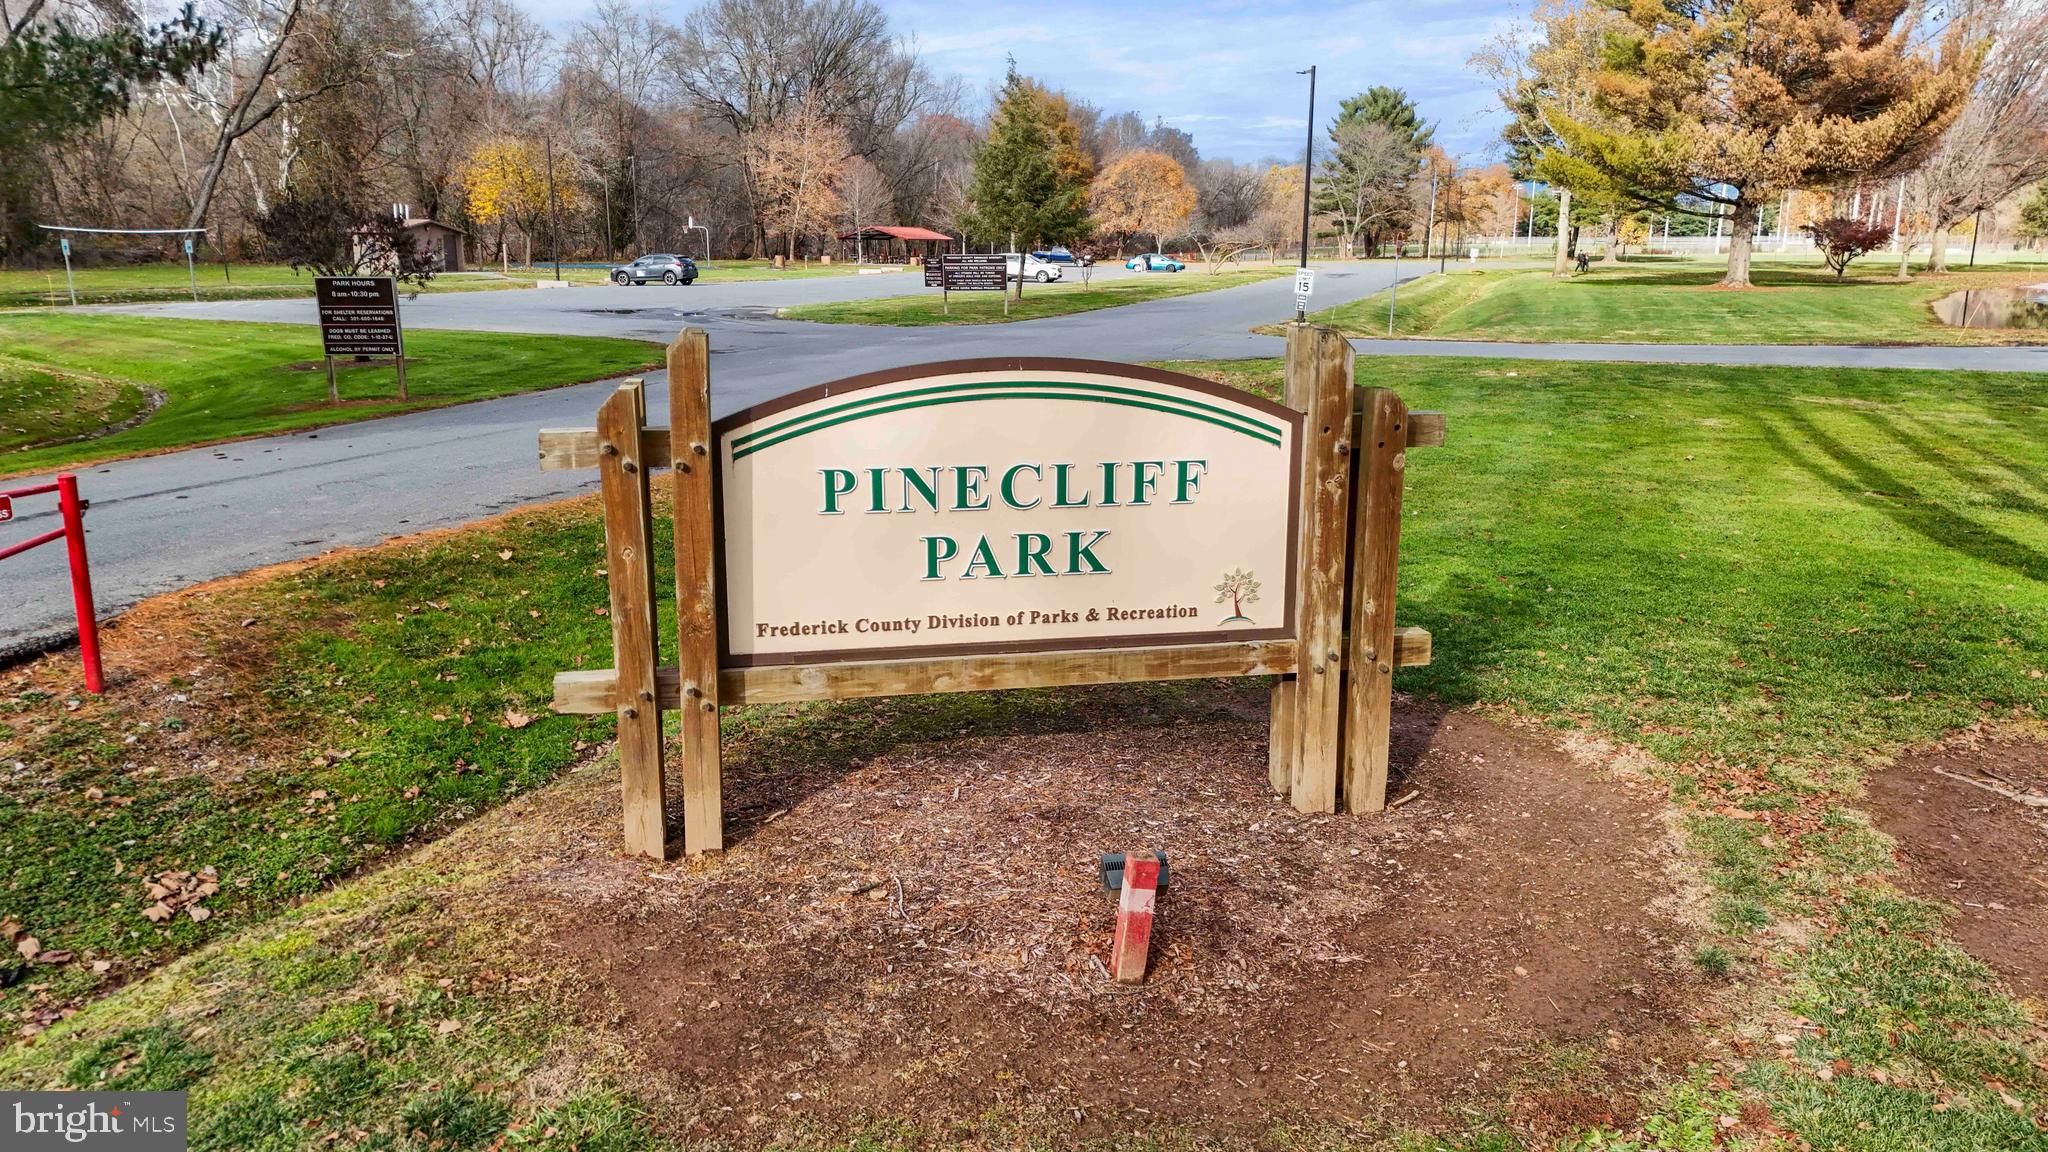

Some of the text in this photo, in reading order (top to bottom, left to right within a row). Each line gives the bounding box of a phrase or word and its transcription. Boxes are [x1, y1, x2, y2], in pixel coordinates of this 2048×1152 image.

[1298, 282, 1309, 292] 15
[817, 458, 1208, 514] PINECLIFF
[919, 530, 1112, 581] PARK
[756, 604, 1198, 638] Frederick County Division of Parks & Recreation
